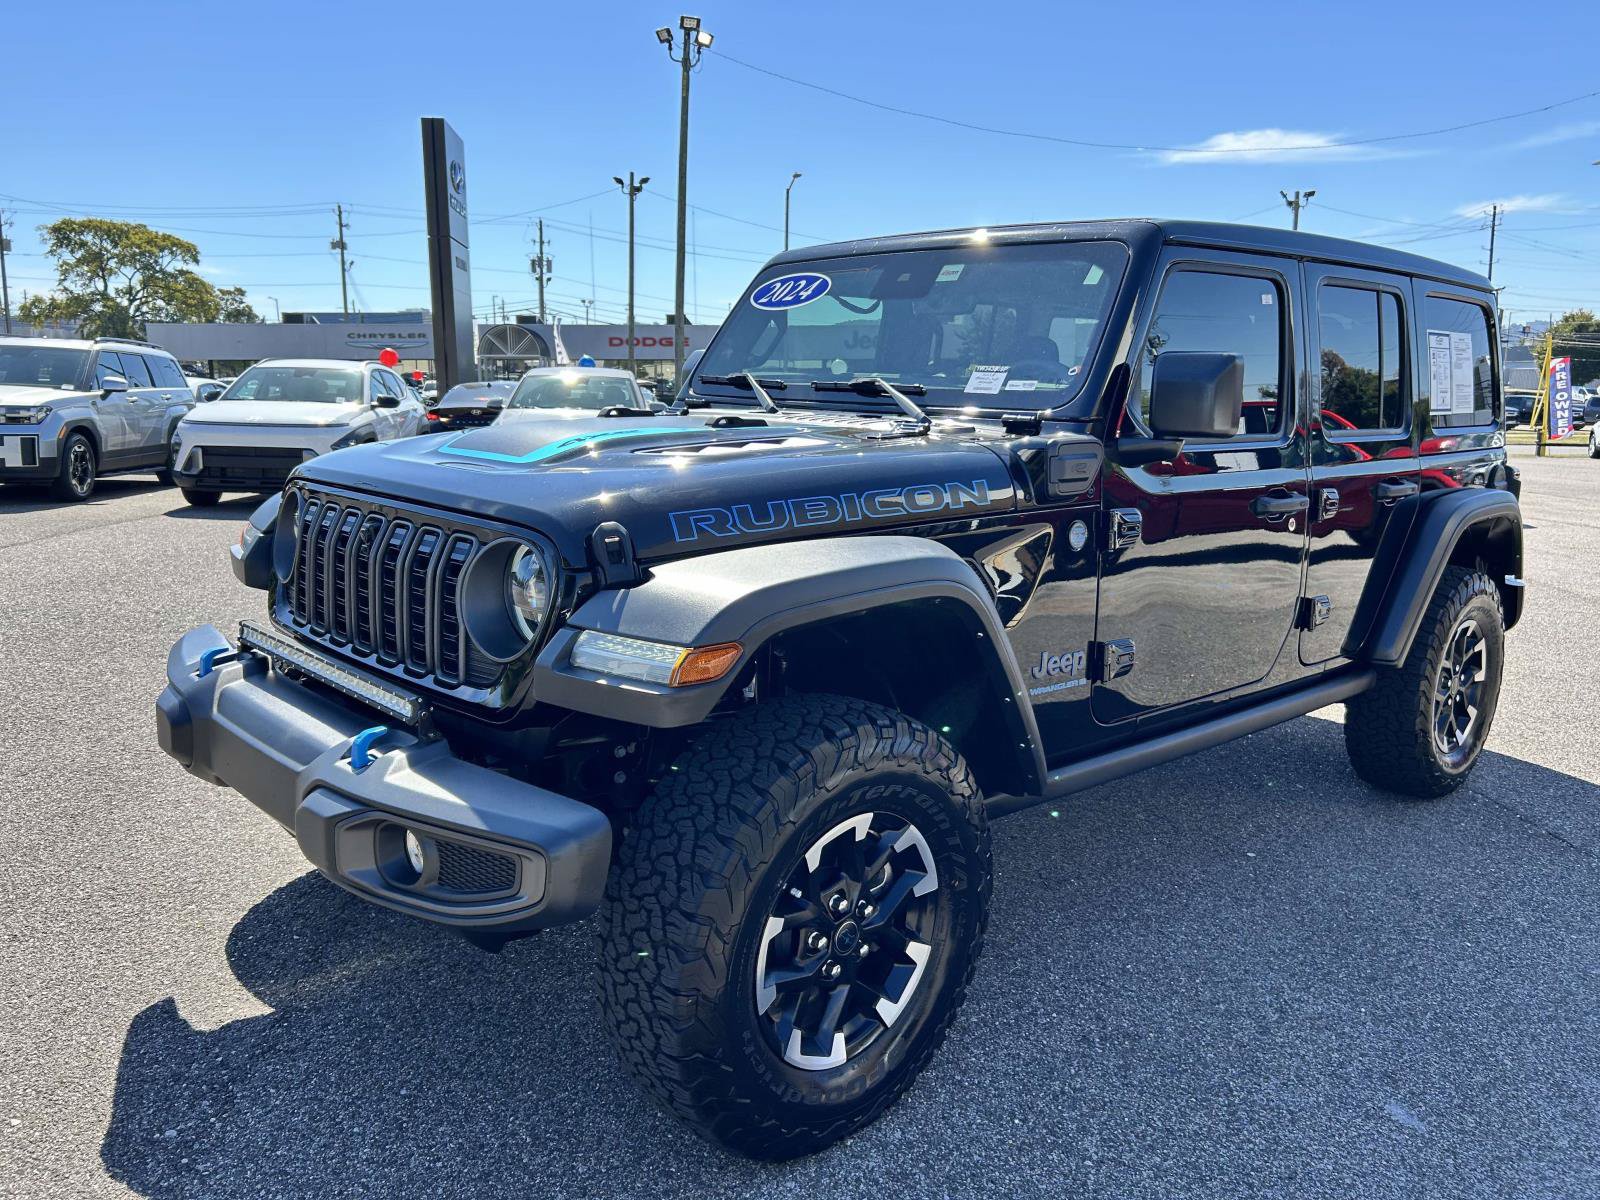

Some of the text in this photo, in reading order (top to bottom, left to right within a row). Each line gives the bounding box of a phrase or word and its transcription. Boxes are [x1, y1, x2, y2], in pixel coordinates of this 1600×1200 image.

[757, 278, 824, 303] 2024
[1554, 362, 1571, 436] PRE OWNED
[668, 479, 991, 542] RUBICON
[1031, 650, 1087, 679] Jeep
